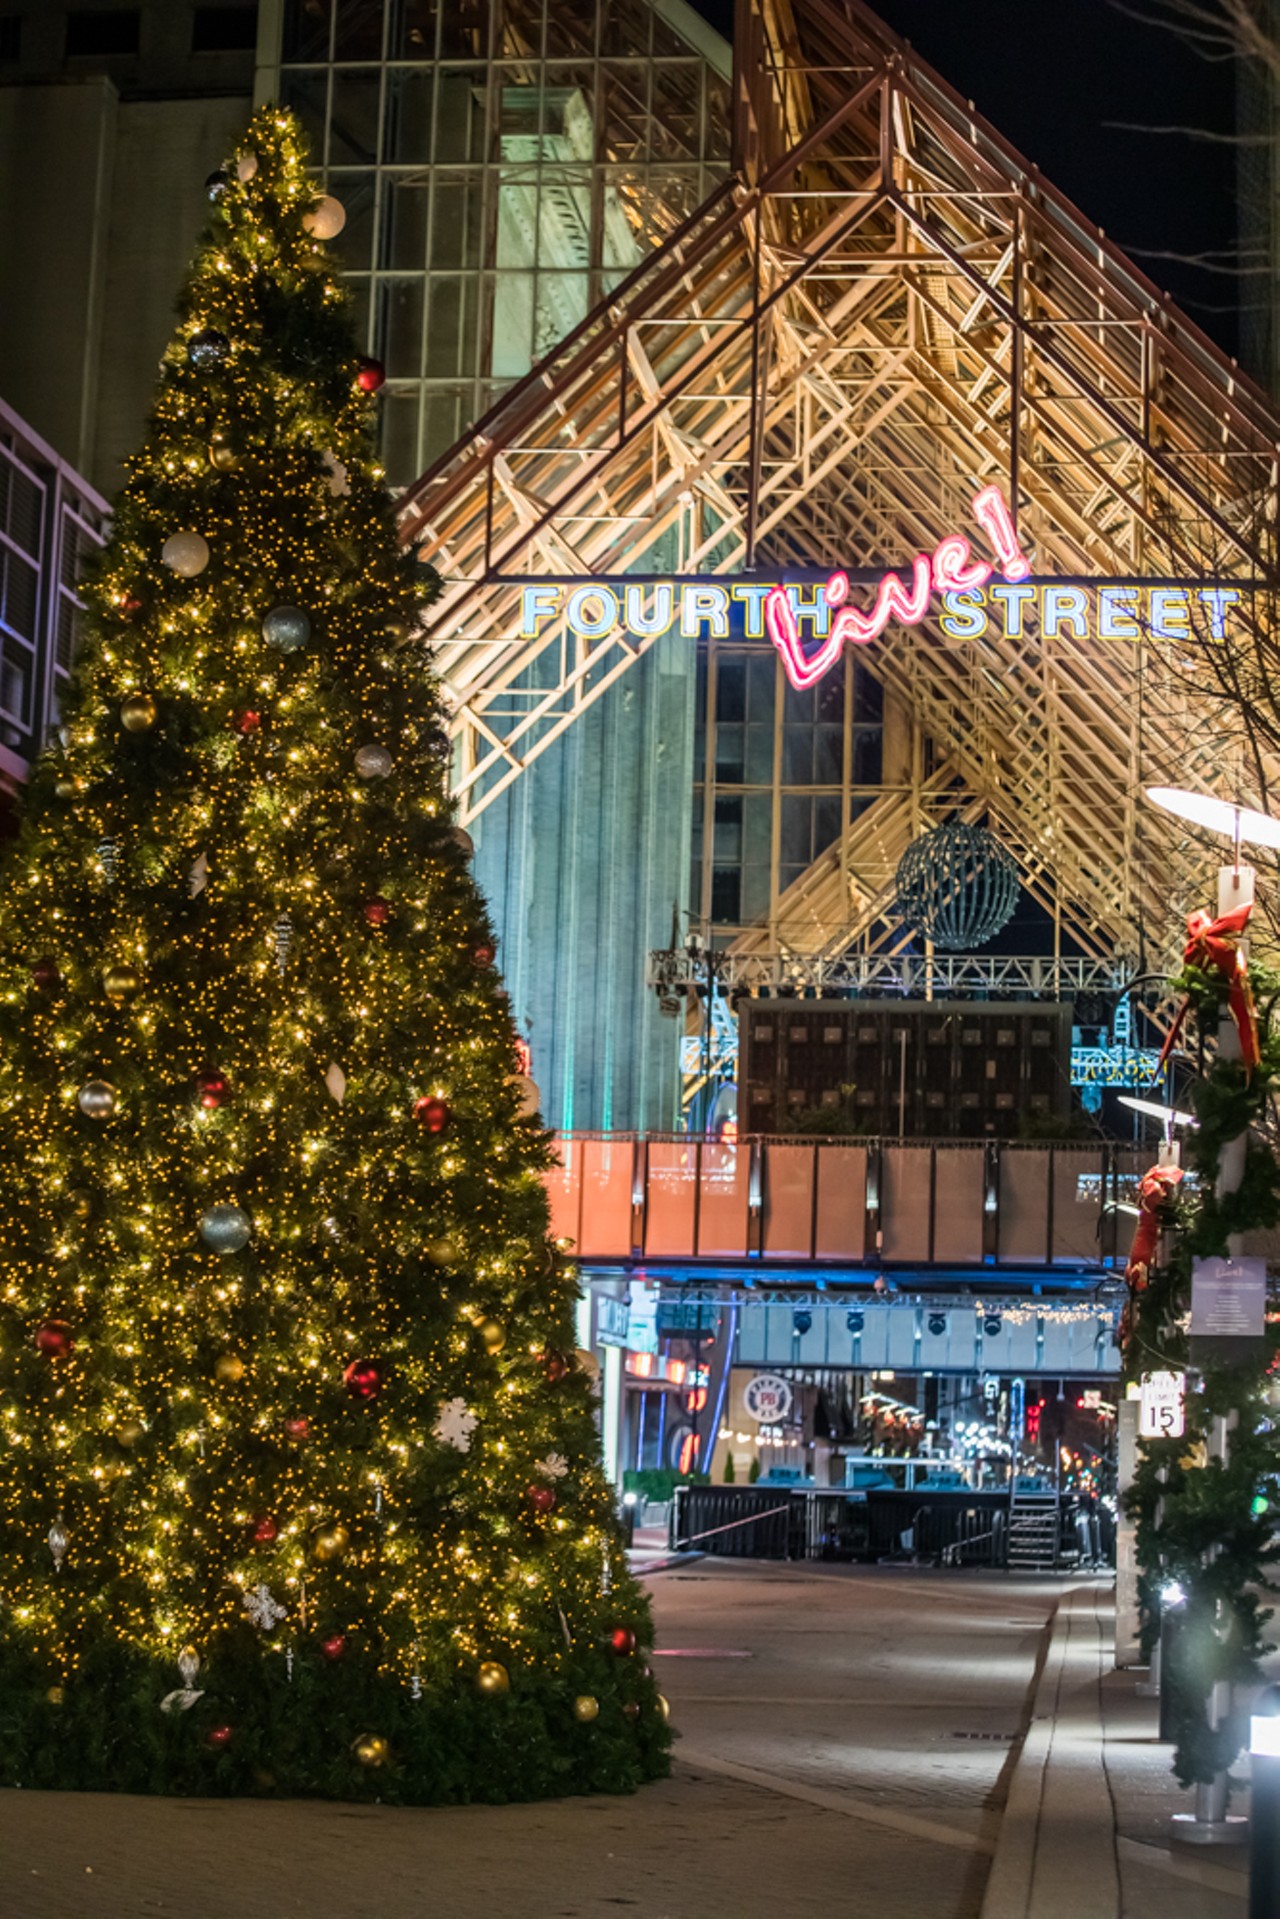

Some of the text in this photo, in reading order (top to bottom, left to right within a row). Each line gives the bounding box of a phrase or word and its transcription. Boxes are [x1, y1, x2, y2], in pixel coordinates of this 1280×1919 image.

[520, 584, 1241, 642] FOURTH STREET
[1149, 1405, 1175, 1429] 15
